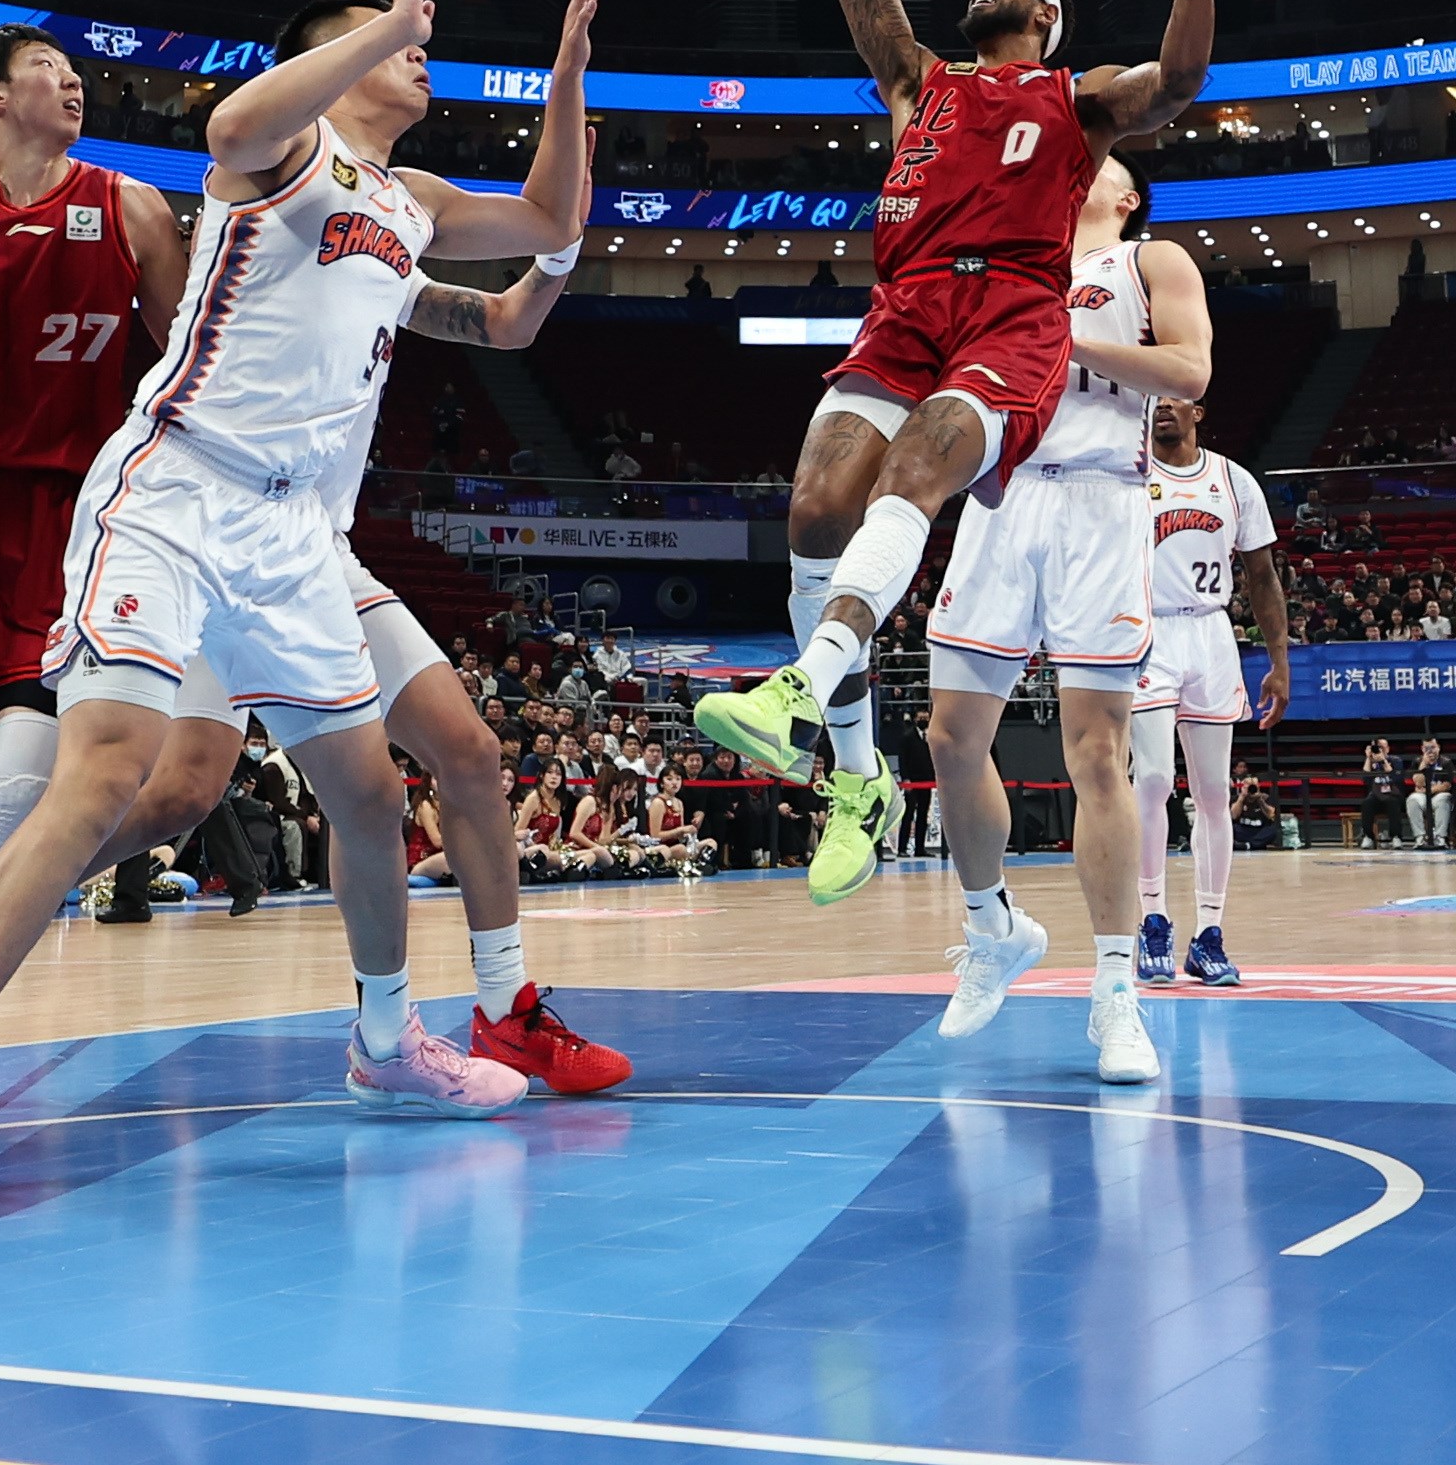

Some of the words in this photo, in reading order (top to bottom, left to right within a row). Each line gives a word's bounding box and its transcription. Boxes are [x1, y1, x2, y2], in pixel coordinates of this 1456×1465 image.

[1290, 60, 1344, 89] PLAY
[1349, 56, 1379, 84] AS
[1382, 54, 1400, 80] A
[1000, 120, 1043, 167] 0
[726, 190, 806, 230] LET'S
[810, 195, 848, 227] GO
[877, 195, 921, 214] 1956
[316, 211, 414, 280] SHARKS
[34, 313, 121, 363] 27
[1154, 508, 1224, 550] HARKS
[1192, 560, 1222, 594] 22
